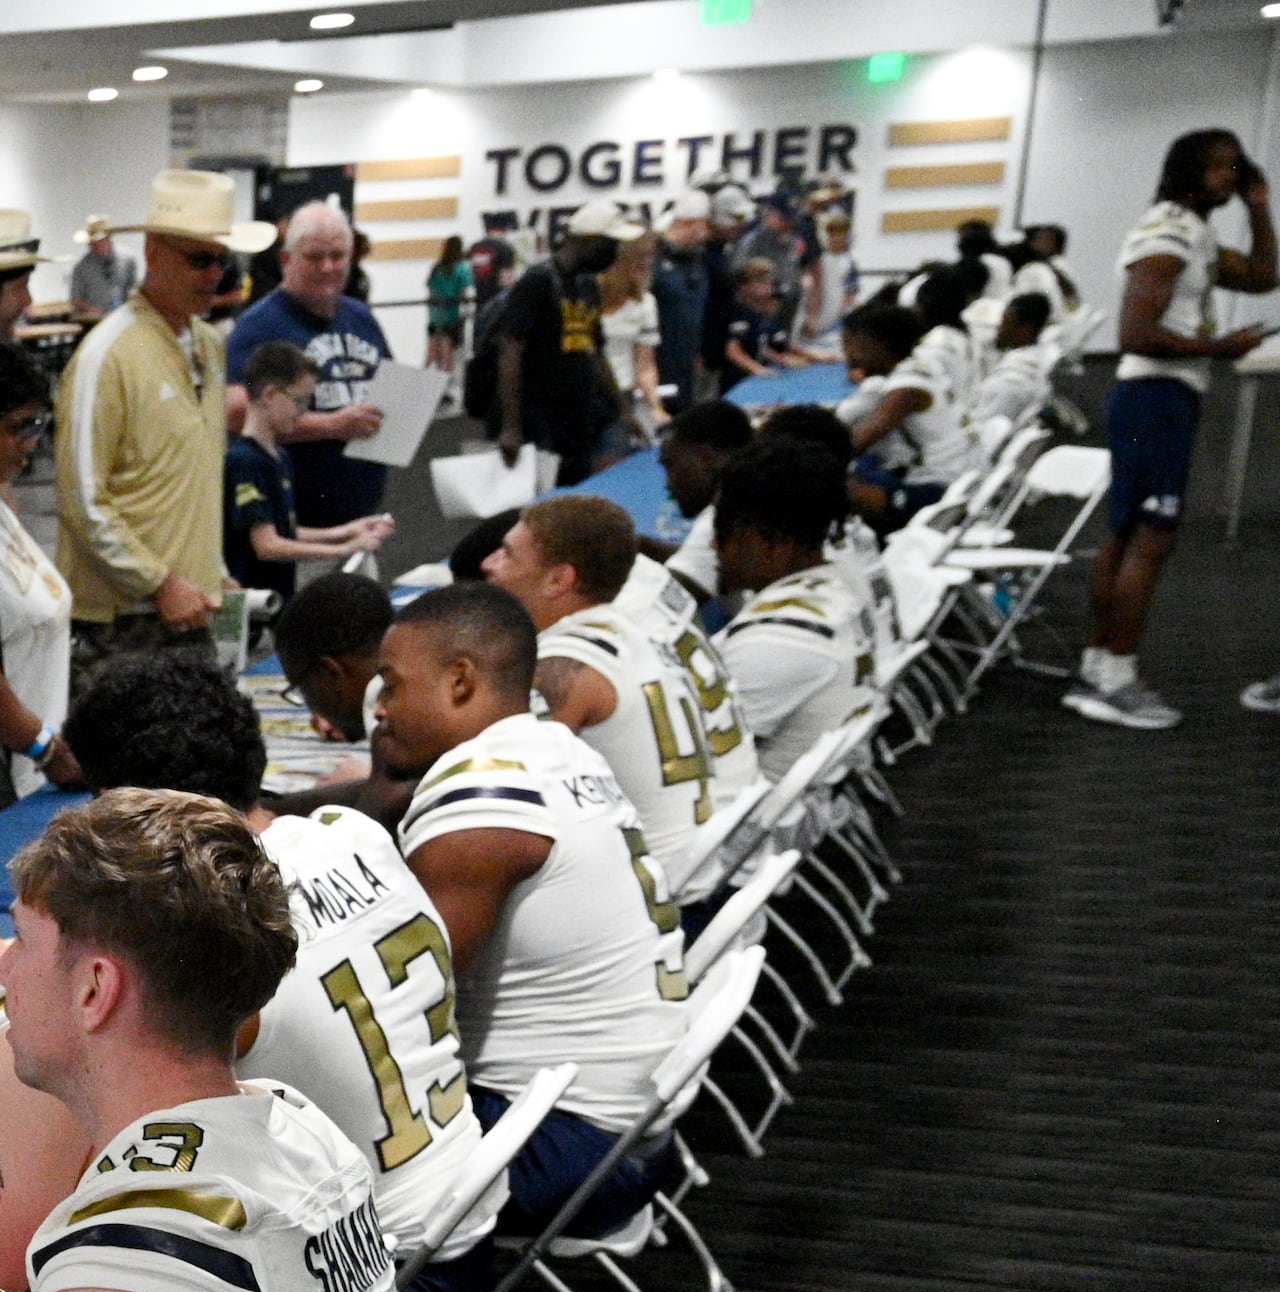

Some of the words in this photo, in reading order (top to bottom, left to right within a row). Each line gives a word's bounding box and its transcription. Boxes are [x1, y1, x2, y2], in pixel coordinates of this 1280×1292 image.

[485, 123, 858, 195] TOGETHER
[303, 853, 391, 929] MOALA
[319, 911, 469, 1174] 13
